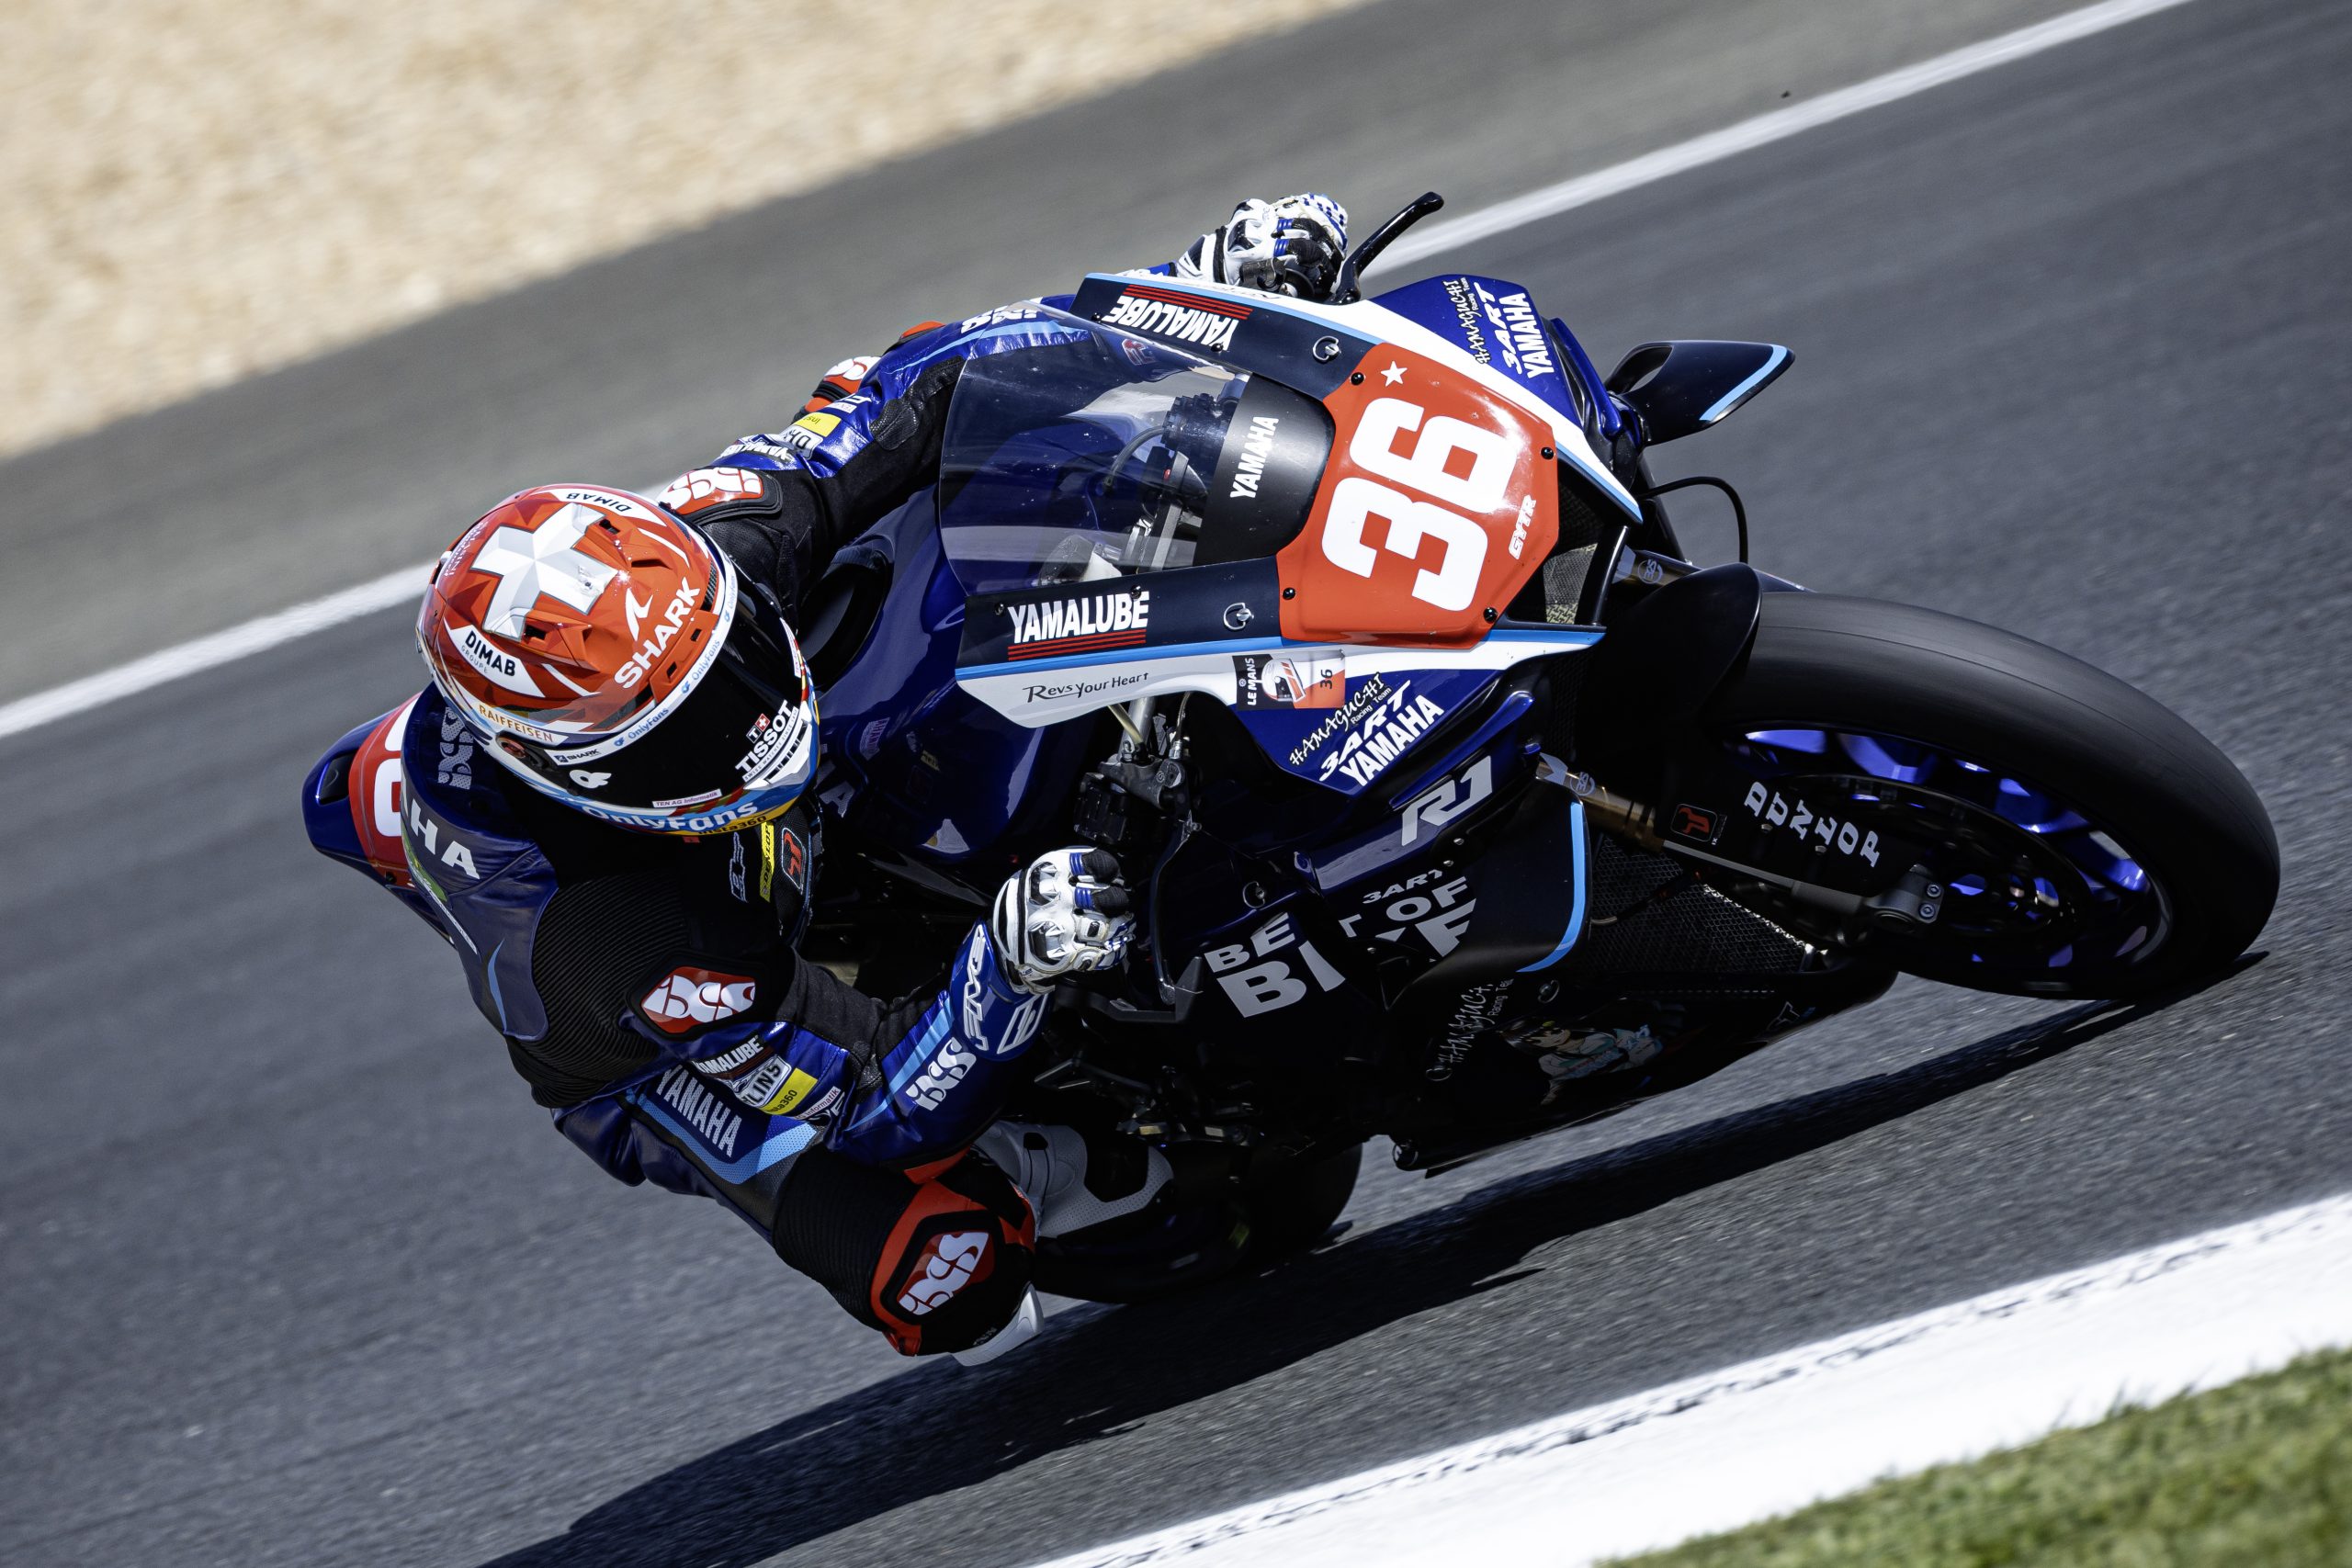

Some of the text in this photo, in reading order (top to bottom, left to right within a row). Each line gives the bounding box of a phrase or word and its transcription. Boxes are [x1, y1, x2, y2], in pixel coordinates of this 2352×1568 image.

[1102, 295, 1240, 351] YAMALUBE
[1514, 293, 1555, 379] YAMAHA
[1229, 415, 1280, 499] YAMAHA
[566, 491, 633, 513] DIMAB
[1322, 397, 1518, 612] 36
[1509, 494, 1536, 559] GYTR
[614, 577, 700, 689] SHARK
[1008, 591, 1150, 644] YAMALUBE
[460, 645, 490, 675] GROUPE
[464, 630, 516, 677] DIMAB
[692, 639, 720, 681] OnlyFans
[1023, 682, 1075, 704] Revs
[1111, 672, 1149, 690] Heart
[1246, 657, 1259, 706] LE MANS
[1320, 669, 1334, 690] 36
[478, 704, 554, 743] RAIFFEISEN
[628, 707, 669, 739] OnlyFans
[1289, 672, 1388, 767] HAMAGUCHI
[1351, 686, 1393, 726] Racing Team
[566, 748, 599, 761] SHARK
[735, 699, 793, 774] TISSOT
[1339, 694, 1445, 787] YAMAHA
[581, 802, 759, 832] OnlyFans
[684, 791, 718, 804] Informatik
[1744, 782, 1882, 868] DUNLOP
[1204, 912, 1296, 974] BE
[1386, 875, 1469, 922] OF
[655, 1064, 742, 1158] YAMAHA
[806, 1088, 841, 1118] Informatik
